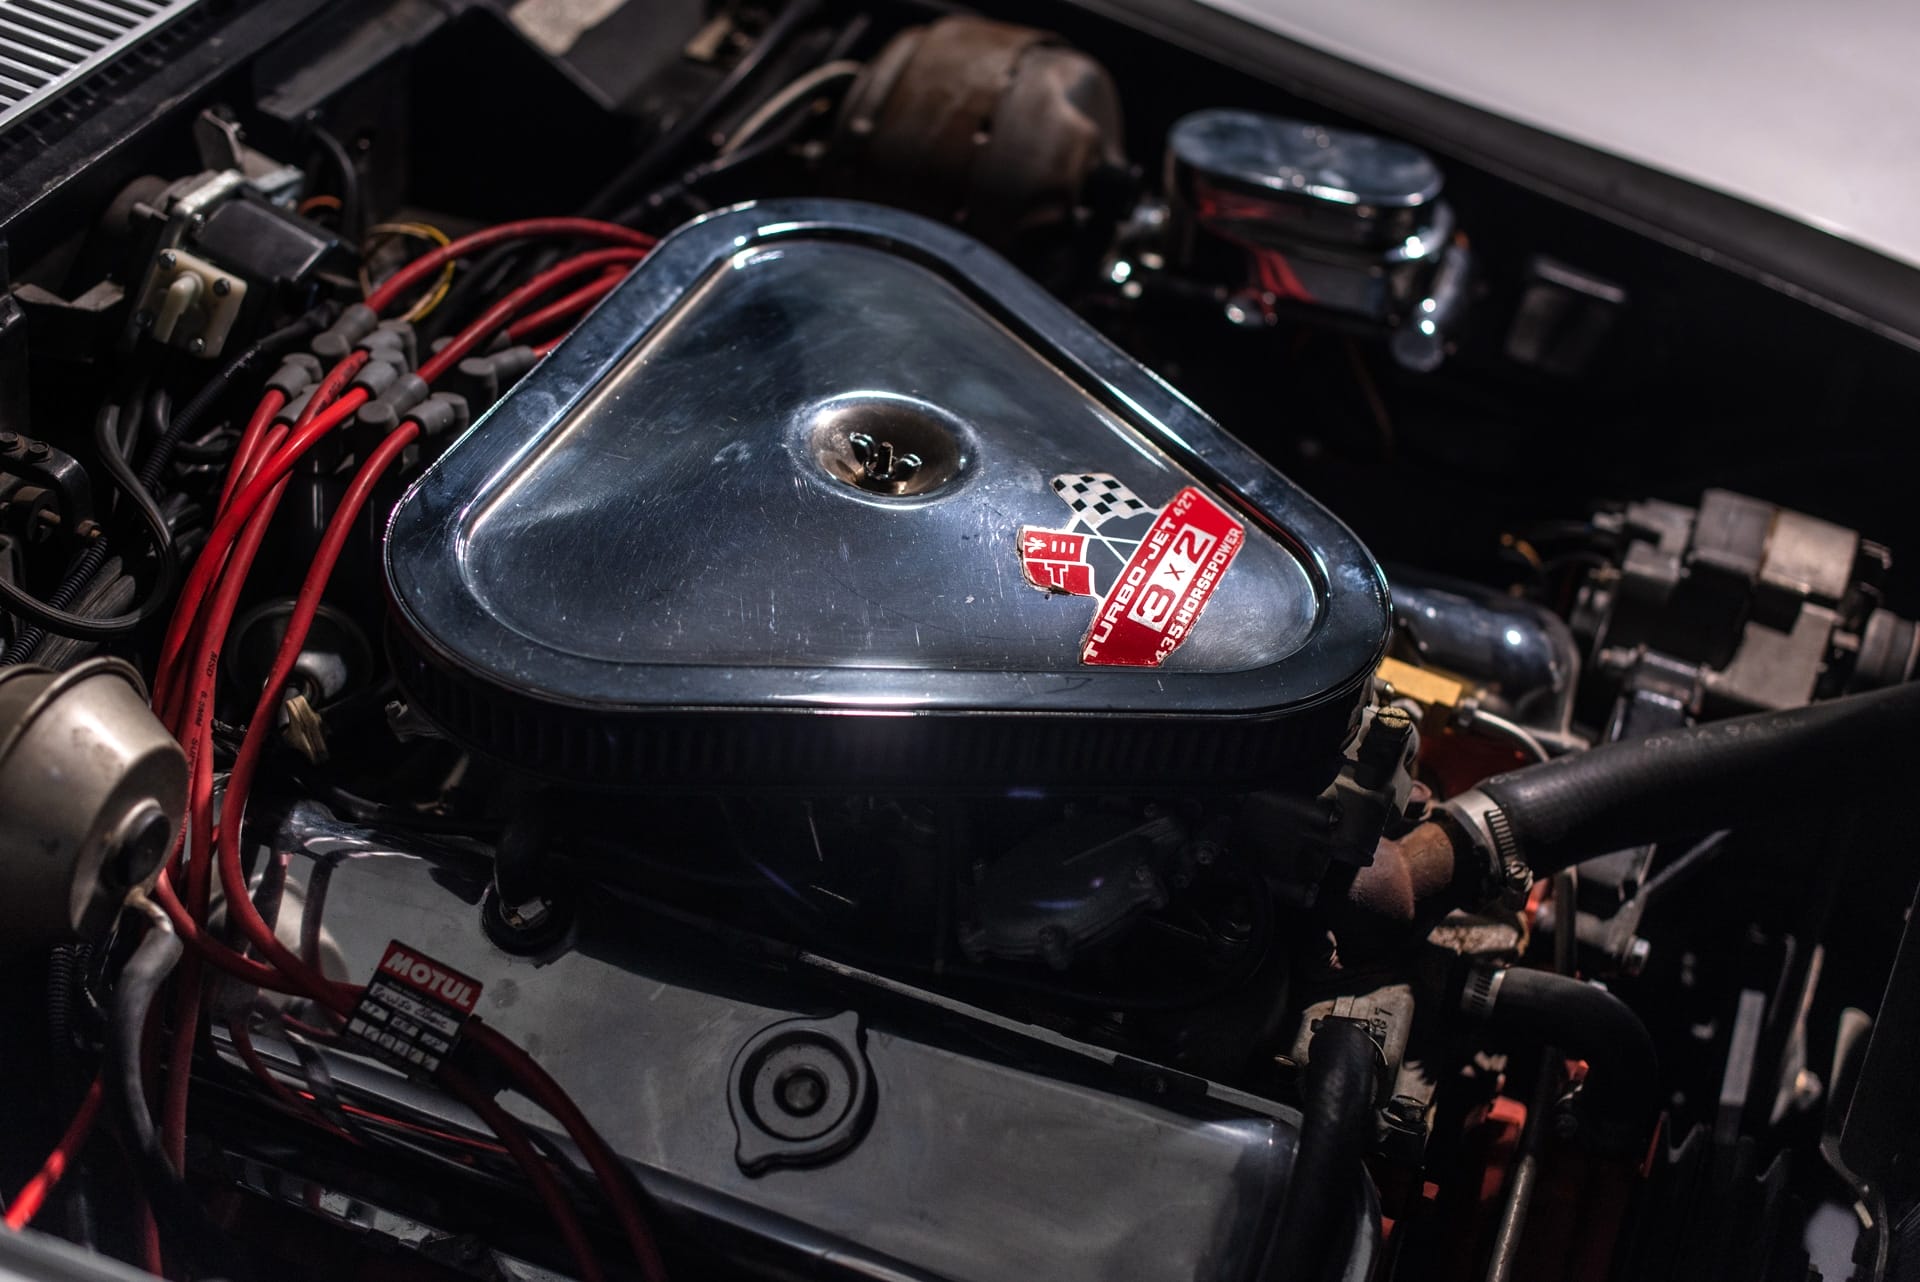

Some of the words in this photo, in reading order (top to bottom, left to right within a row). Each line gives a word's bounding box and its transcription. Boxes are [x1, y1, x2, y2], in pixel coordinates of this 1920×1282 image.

[1083, 517, 1176, 659] TURBO-JET
[1172, 491, 1197, 517] 427
[1136, 583, 1176, 623] 3
[1174, 531, 1208, 565] 2
[1155, 626, 1183, 662] 435
[1176, 528, 1242, 624] HORSEPOWER
[206, 650, 218, 677] MSD
[384, 952, 473, 1007] MOTUL
